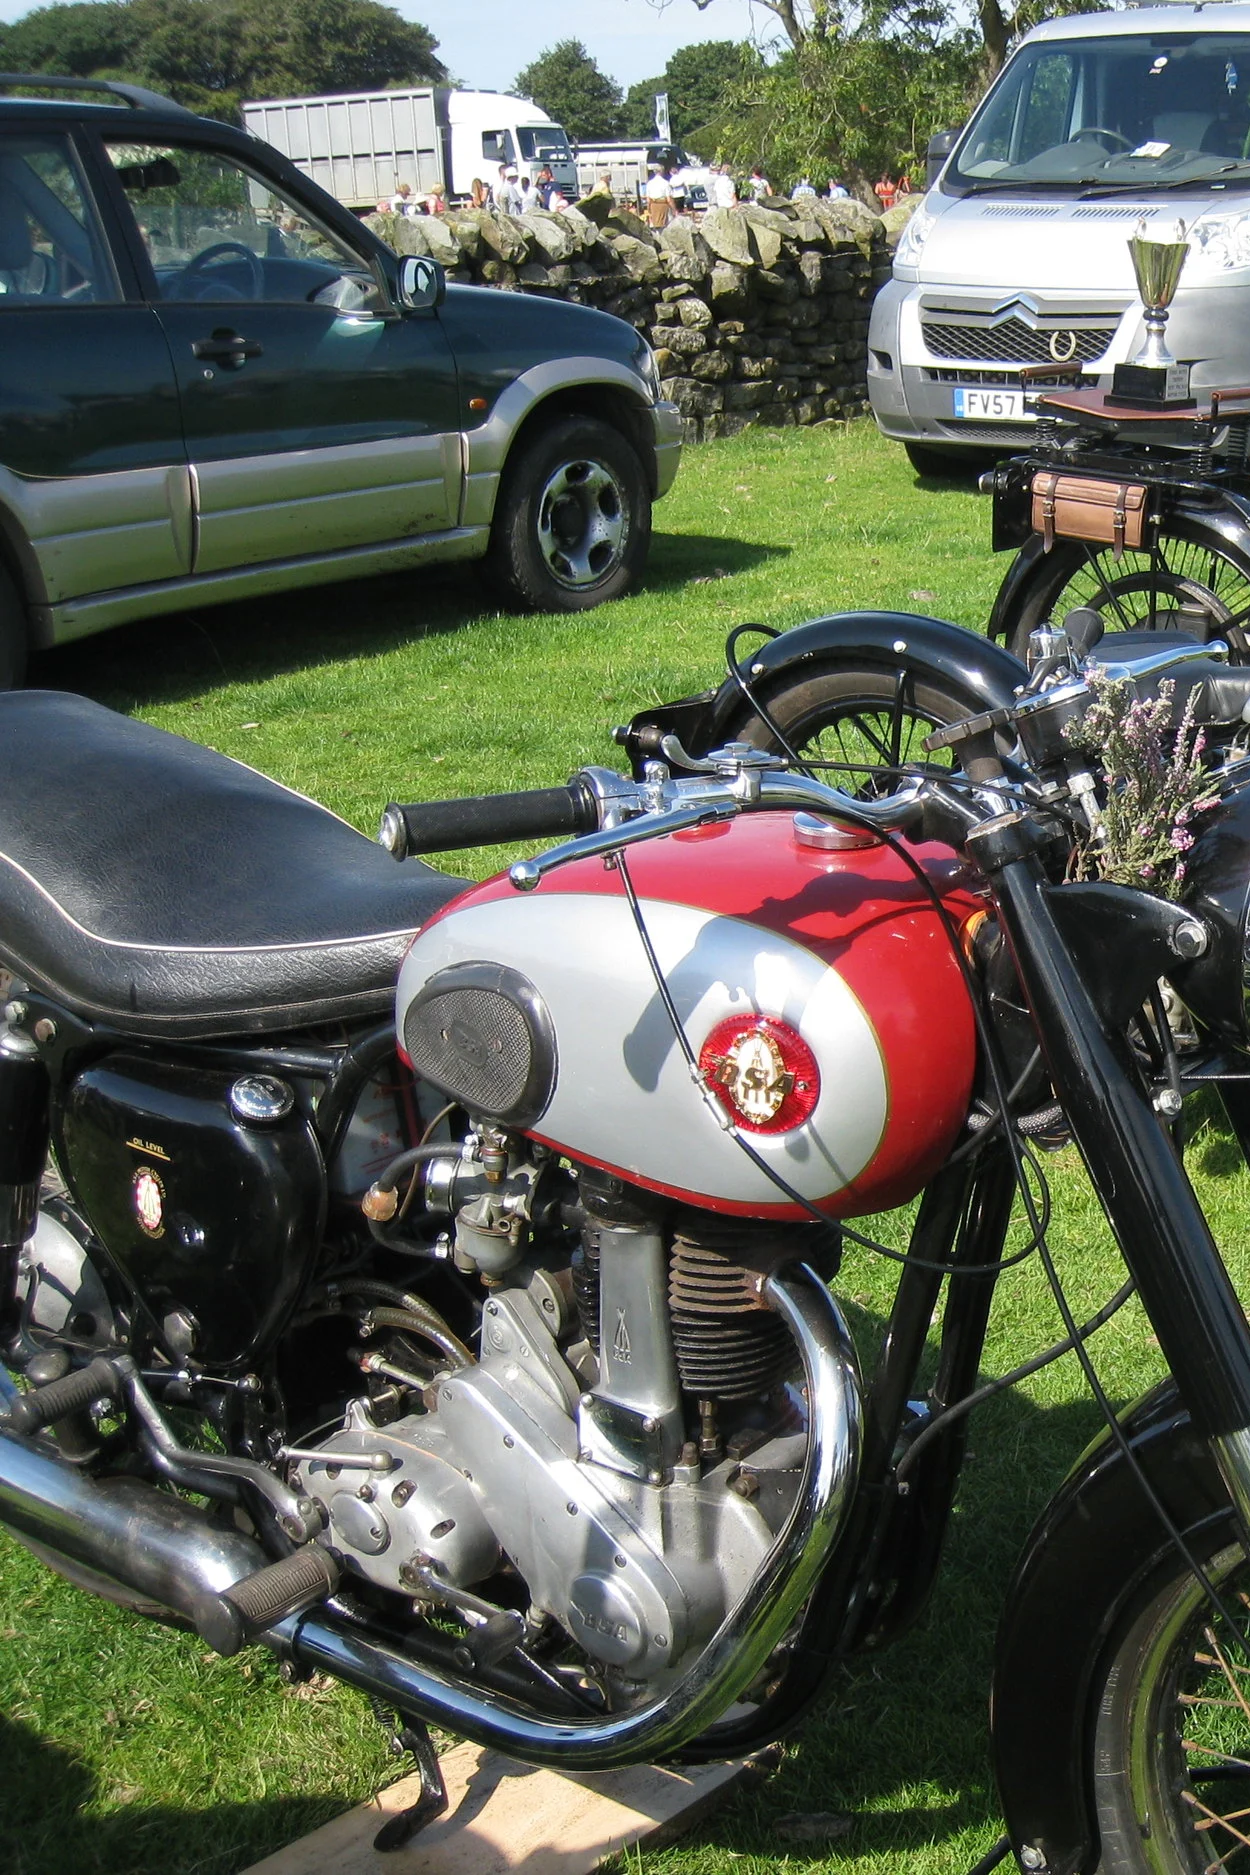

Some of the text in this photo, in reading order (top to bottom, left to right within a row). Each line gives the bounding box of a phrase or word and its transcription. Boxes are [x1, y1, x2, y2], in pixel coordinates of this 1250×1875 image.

[967, 393, 1016, 416] FV57
[713, 1058, 796, 1097] BSA
[132, 1137, 165, 1155] OIL LEVEL
[583, 1610, 629, 1645] BSA
